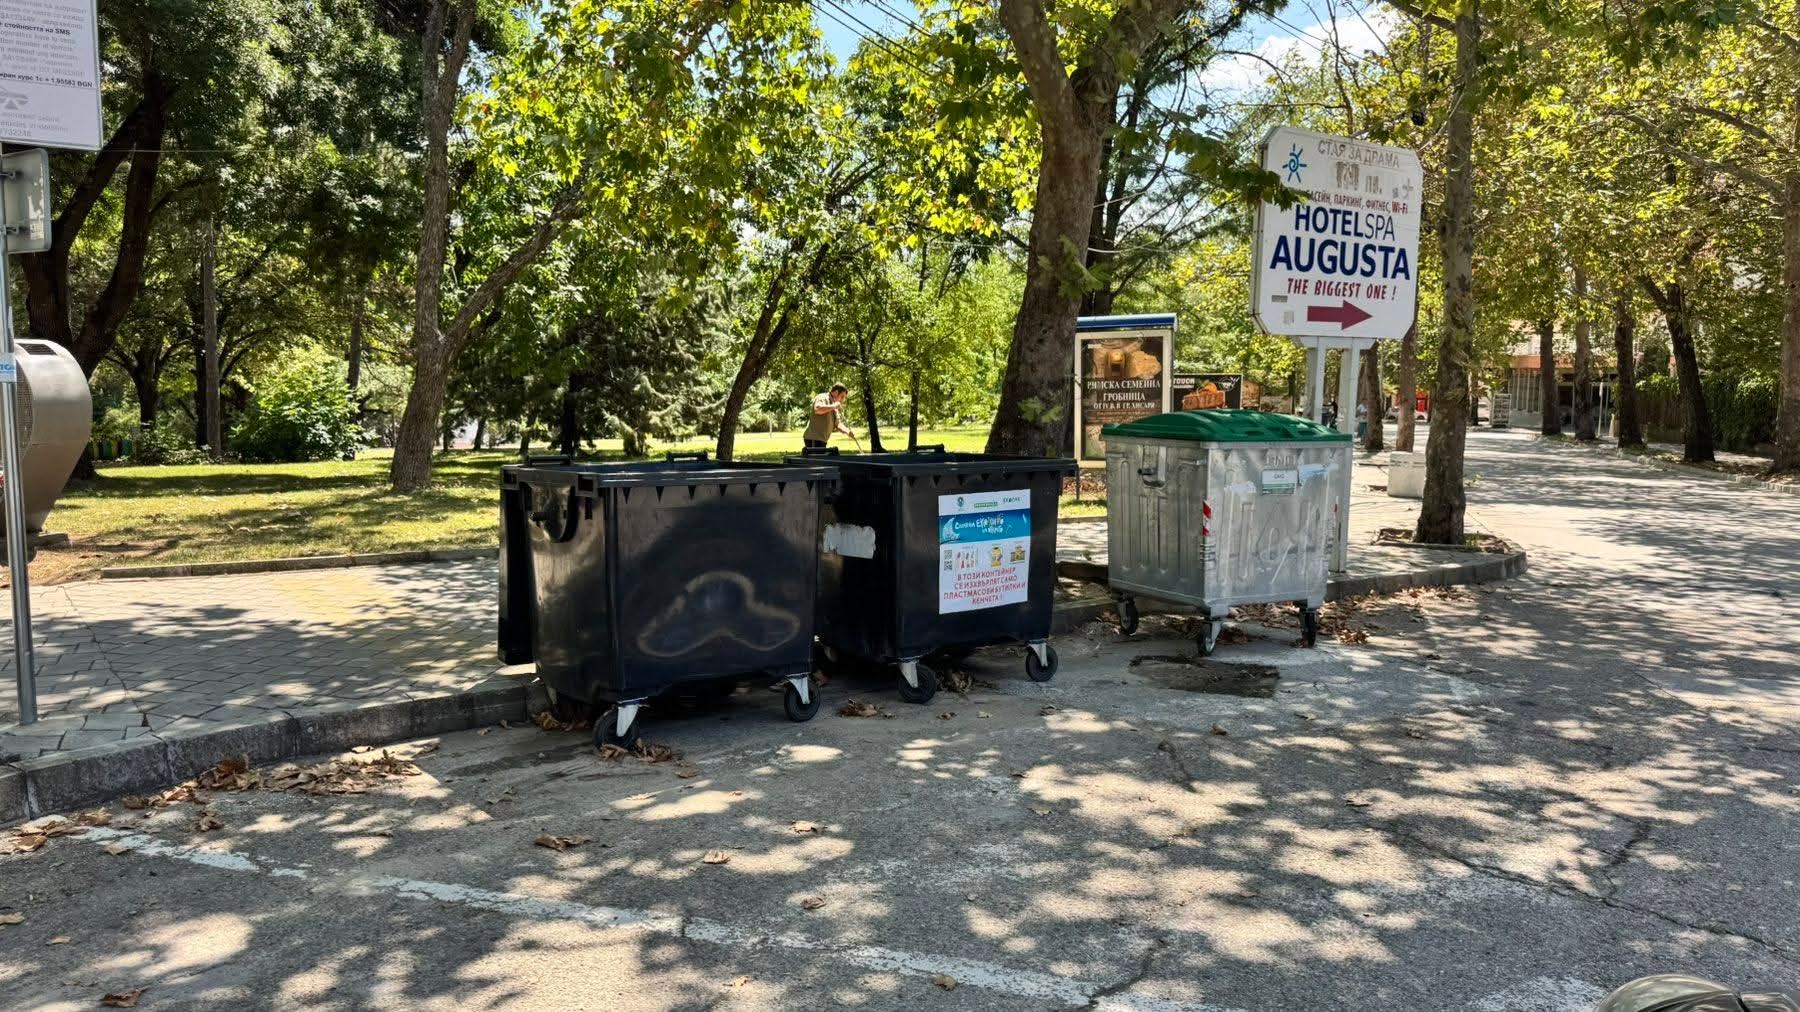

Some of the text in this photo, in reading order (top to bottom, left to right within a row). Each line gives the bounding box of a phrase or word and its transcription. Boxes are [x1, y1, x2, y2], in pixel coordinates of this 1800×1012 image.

[1348, 146, 1362, 161] ЗА
[1391, 200, 1408, 214] Wi-Fi
[1295, 204, 1395, 241] HOTEL SPA
[1270, 235, 1410, 280] AUGUSTA
[1287, 278, 1308, 295] THE
[1314, 280, 1360, 298] BIGGEST
[1366, 284, 1387, 300] ONE
[1103, 392, 1146, 401] ГРОБНИЦА
[982, 567, 1016, 578] КОНТЕЙНЕР
[1000, 575, 1017, 583] САМО
[944, 588, 994, 600] ПЛАСТМАСОВИ
[994, 584, 1020, 593] БУТИЛКИ
